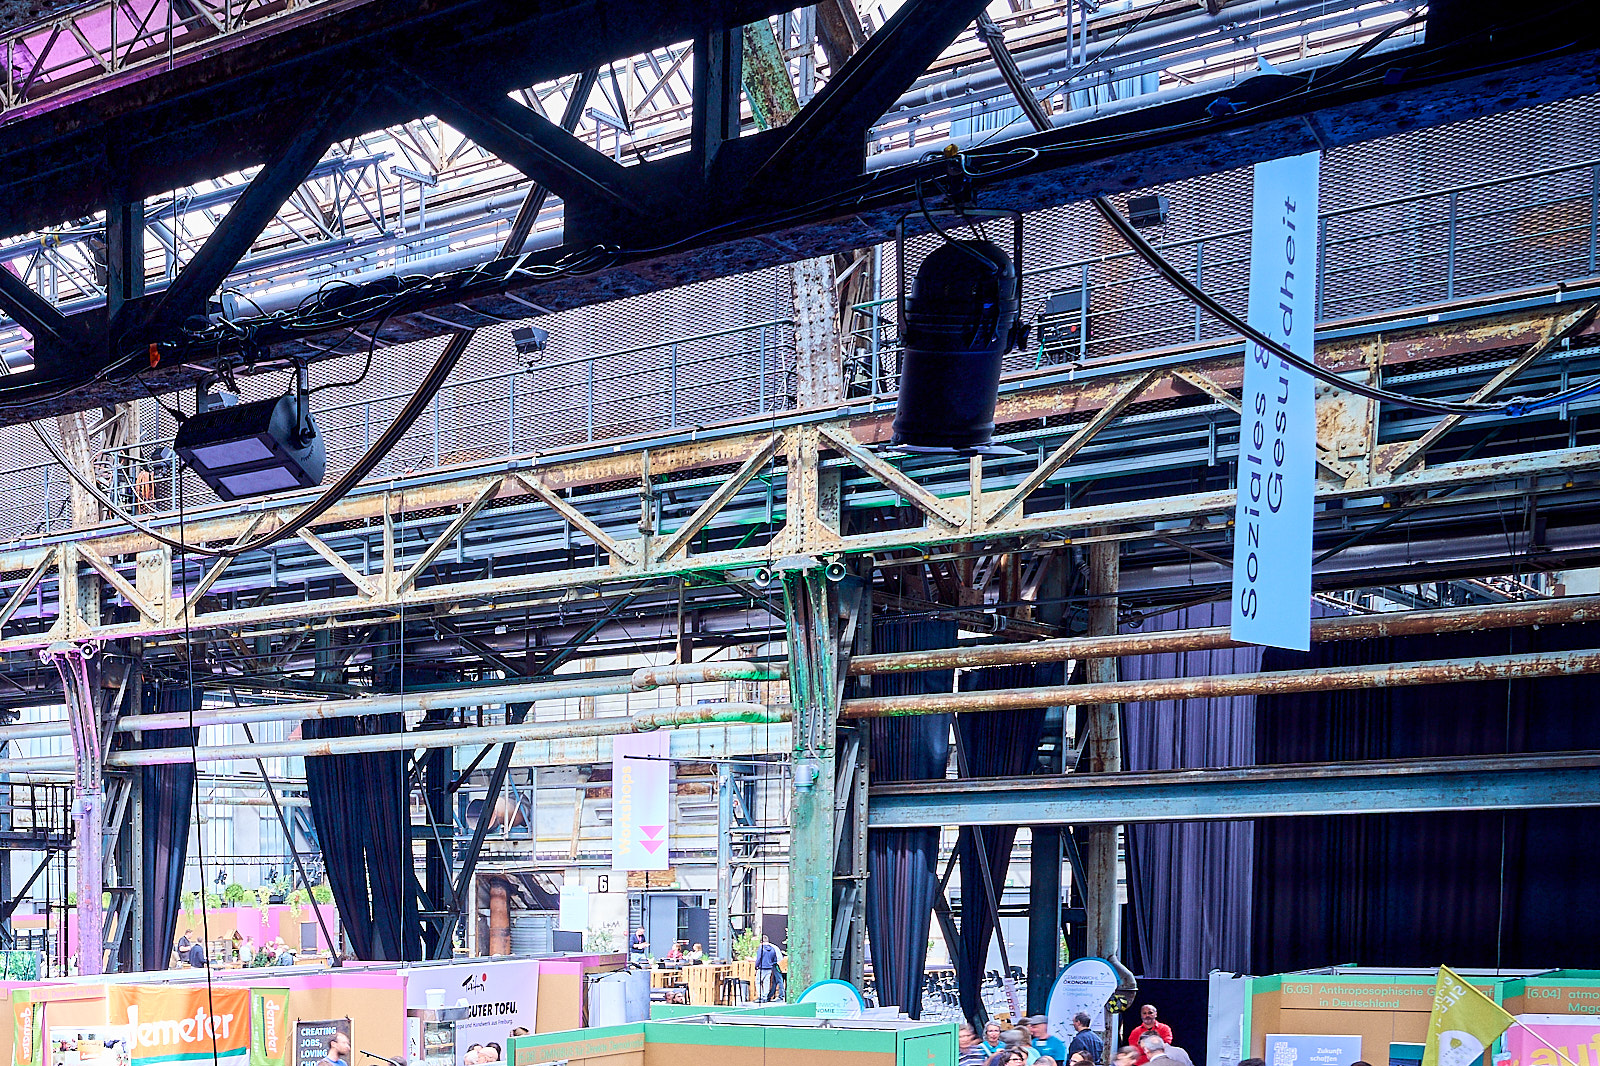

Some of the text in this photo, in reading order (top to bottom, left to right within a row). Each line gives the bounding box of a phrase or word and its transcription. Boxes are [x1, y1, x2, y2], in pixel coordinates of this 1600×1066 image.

[1240, 391, 1267, 621] Soziales
[619, 765, 634, 856] Workshops
[598, 874, 609, 893] 6
[1283, 984, 1314, 995] [6.05]
[1319, 985, 1424, 997] Anthroposophische
[1527, 987, 1561, 1000] [6.04]
[1319, 997, 1400, 1009] in Deutschland
[468, 1001, 518, 1020] GUTER TOFU.
[125, 1004, 234, 1049] demeter
[300, 1026, 337, 1036] CREATING
[300, 1038, 323, 1048] JOBS,
[300, 1048, 328, 1058] LOVING
[539, 1044, 574, 1059] OMNIBUS
[574, 1043, 584, 1057] für
[1316, 1047, 1343, 1056] Zukunft
